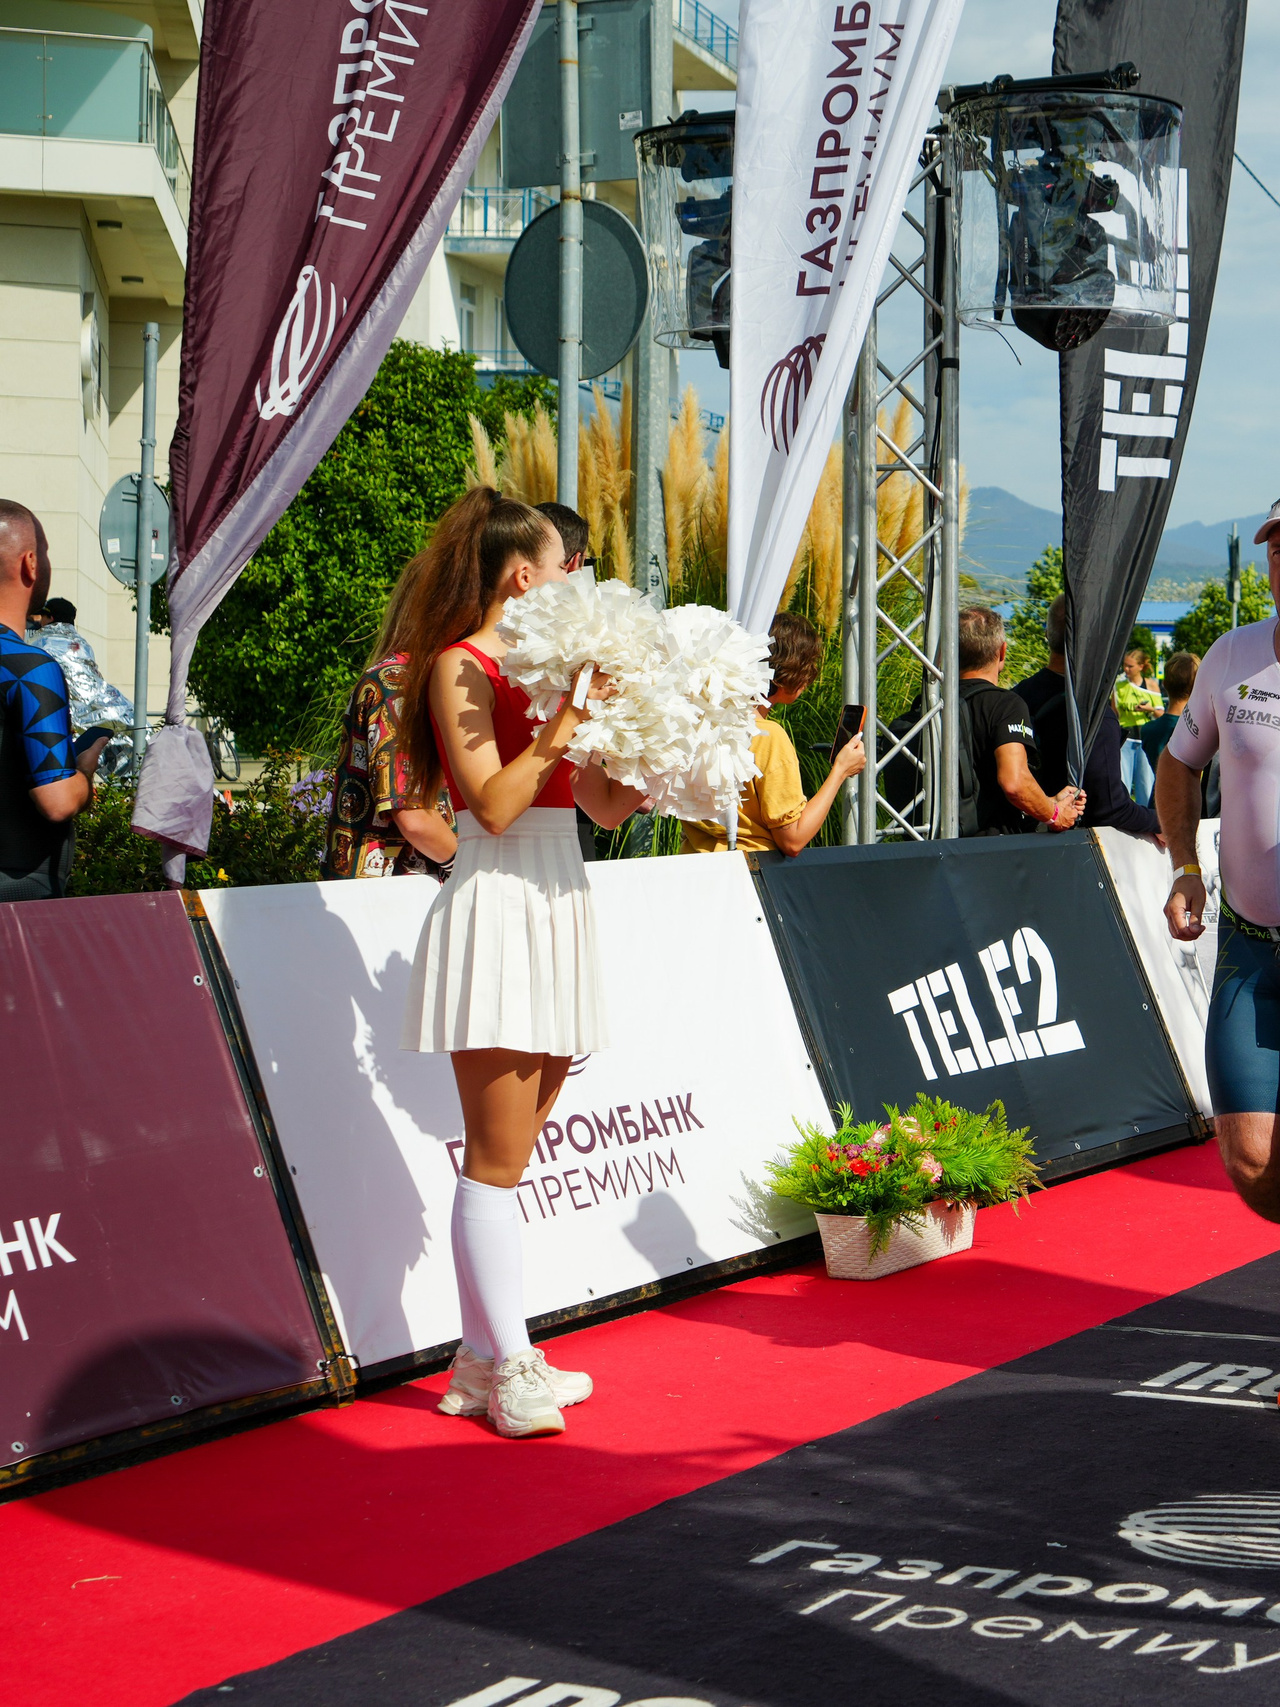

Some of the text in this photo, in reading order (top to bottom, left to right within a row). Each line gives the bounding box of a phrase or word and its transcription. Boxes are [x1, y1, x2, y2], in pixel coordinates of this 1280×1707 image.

[887, 926, 1085, 1081] TELE2
[445, 1092, 705, 1178] ГРОМБАНК
[517, 1147, 686, 1224] ПРЕМИУМ
